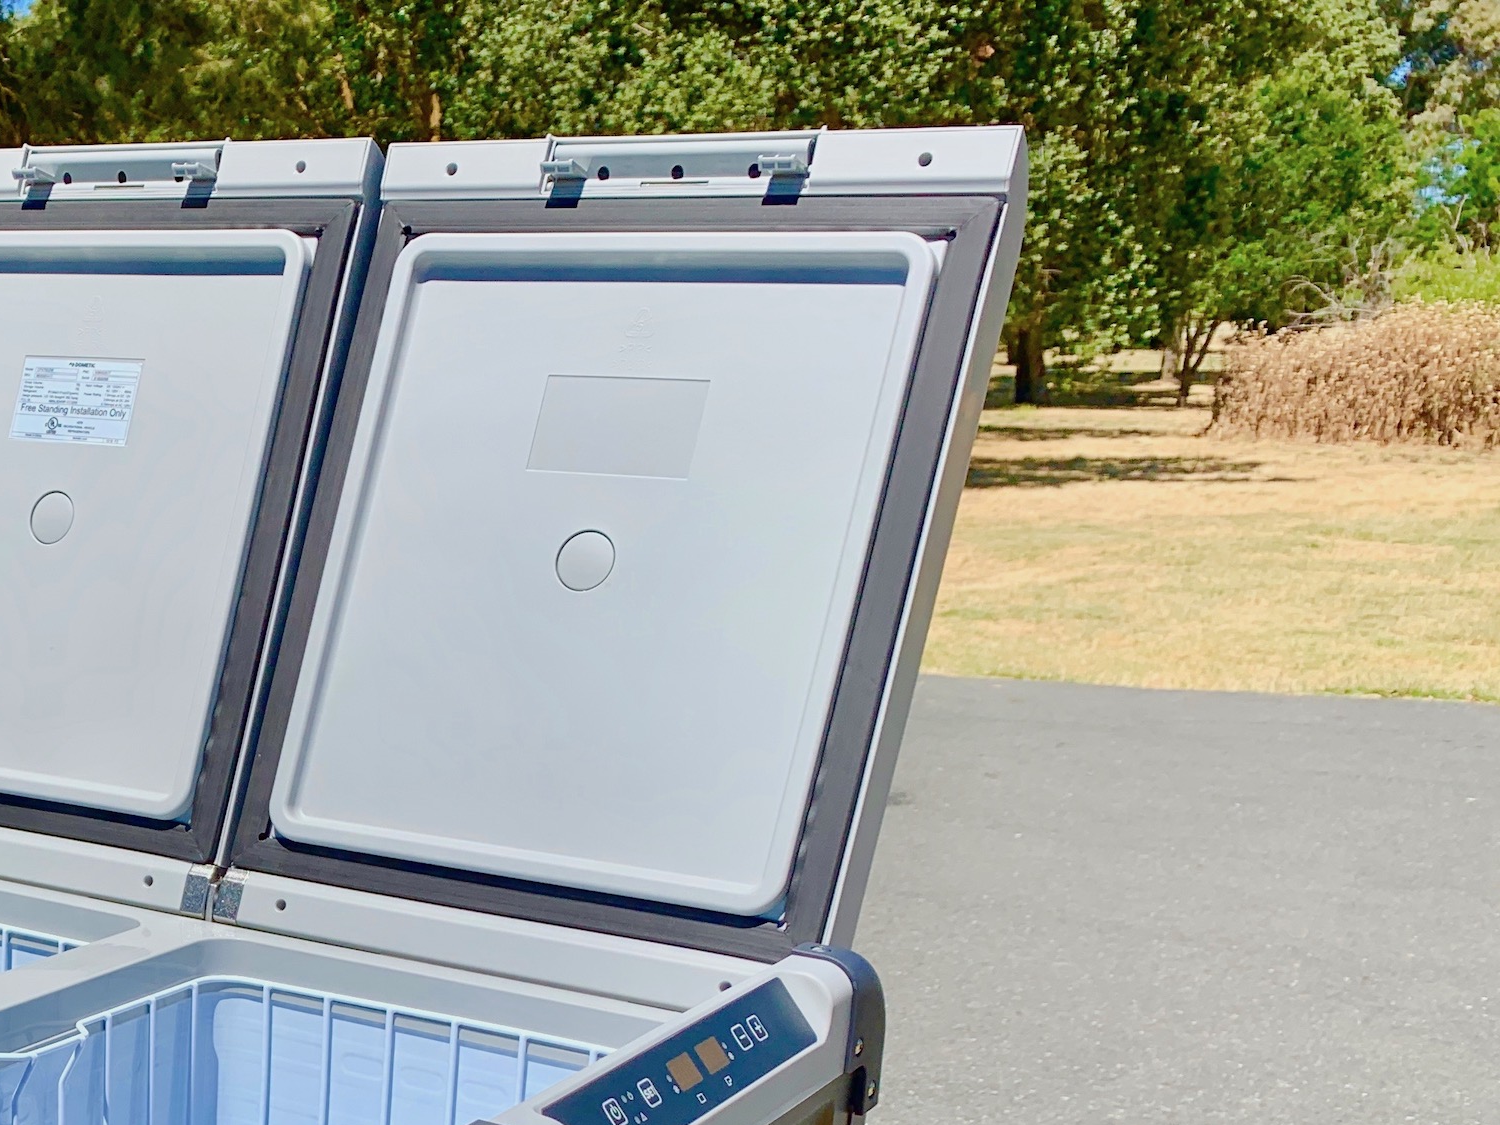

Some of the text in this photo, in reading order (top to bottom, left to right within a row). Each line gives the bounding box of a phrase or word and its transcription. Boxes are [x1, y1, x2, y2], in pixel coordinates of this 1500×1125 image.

[20, 403, 126, 419] Free Standing Installation Only
[642, 1085, 657, 1099] SET
